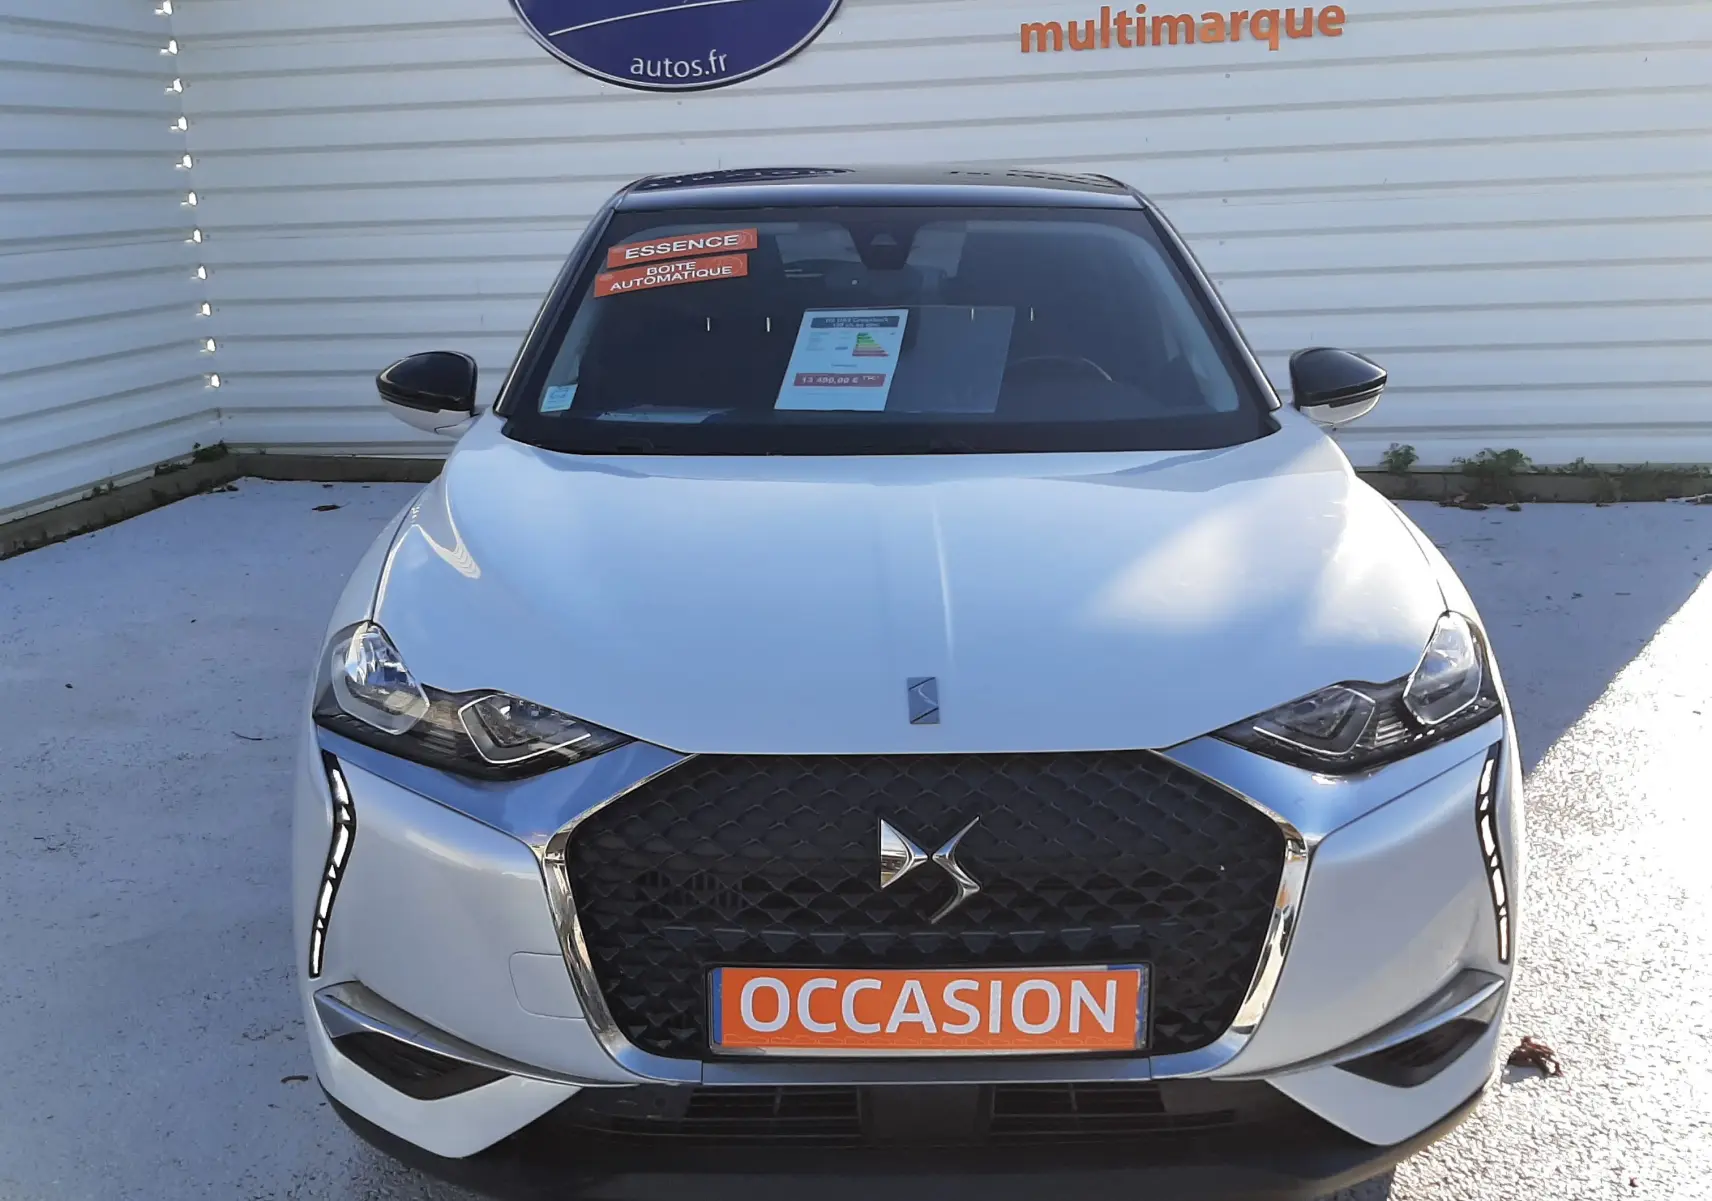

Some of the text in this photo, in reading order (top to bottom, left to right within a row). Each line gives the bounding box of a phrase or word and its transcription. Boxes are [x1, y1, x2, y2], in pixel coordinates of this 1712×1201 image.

[1020, 3, 1346, 53] multimarque
[630, 49, 728, 78] autos.fr
[625, 234, 740, 260] ESSENCE
[610, 265, 733, 291] AUTOMATIQUE
[646, 261, 697, 276] BOITE
[739, 976, 1118, 1034] OCCASION
